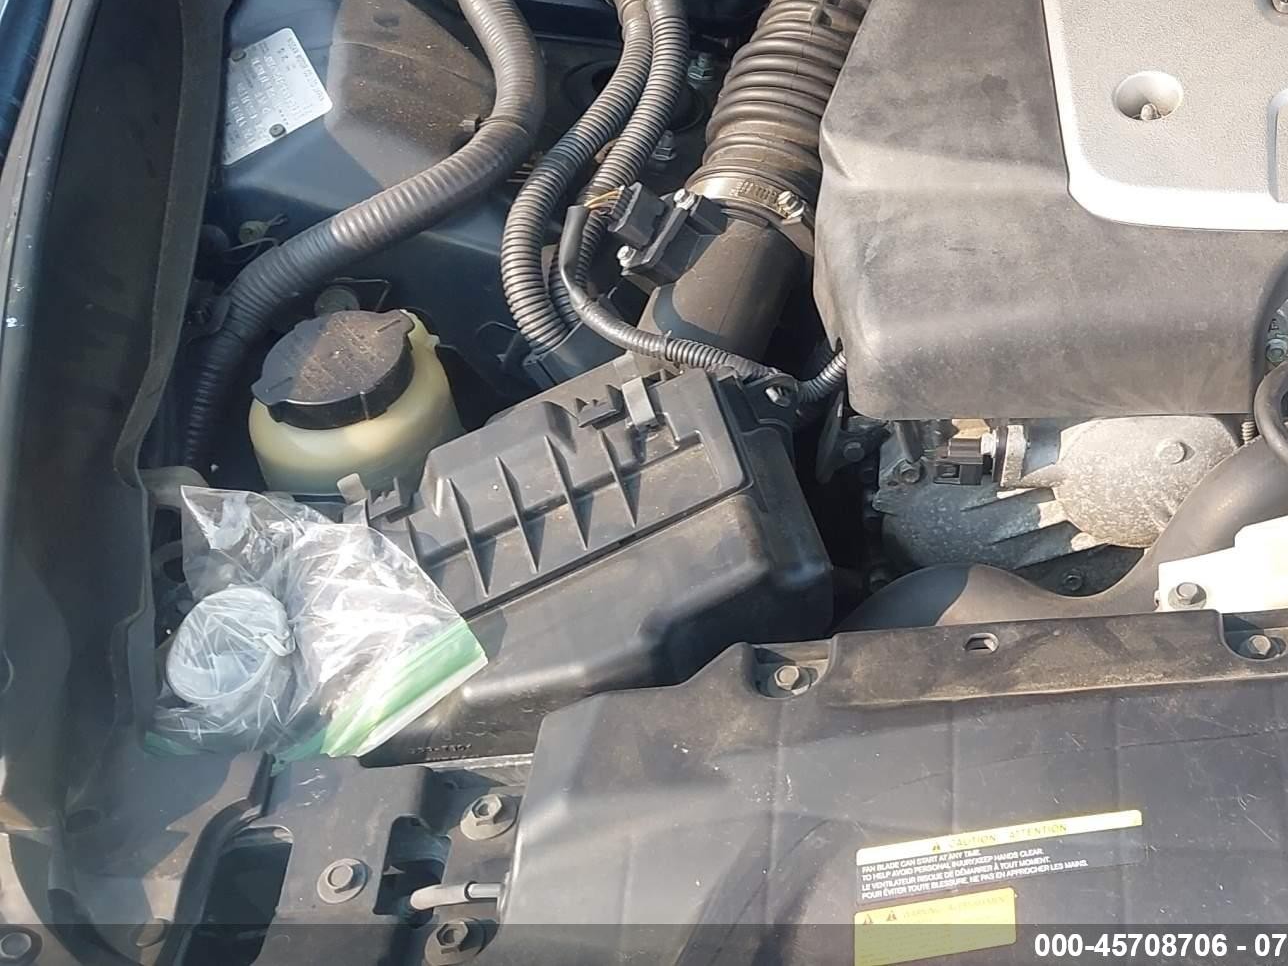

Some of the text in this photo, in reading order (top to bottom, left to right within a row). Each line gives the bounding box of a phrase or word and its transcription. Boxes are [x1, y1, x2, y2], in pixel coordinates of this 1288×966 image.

[861, 864, 876, 872] FAN
[876, 861, 899, 870] BLADE
[899, 859, 915, 867] CAN
[916, 855, 938, 864] START
[949, 851, 963, 859] ANY
[861, 873, 871, 881] TO
[872, 870, 891, 879] HELP
[891, 867, 912, 876] AVOID
[913, 861, 950, 873] PERSONAL
[993, 851, 1018, 861] HANDS
[871, 876, 916, 889] VENTILATEUR
[916, 872, 943, 882] RISQUE
[943, 870, 954, 878] DE
[999, 861, 1018, 869] TOUT
[861, 889, 882, 899] POUR
[907, 882, 930, 892] TOUTE
[968, 875, 979, 883] NE
[980, 872, 994, 881] PAS
[995, 871, 1005, 879] EN
[1005, 864, 1049, 877] APPROCHER
[1050, 862, 1063, 871] LES
